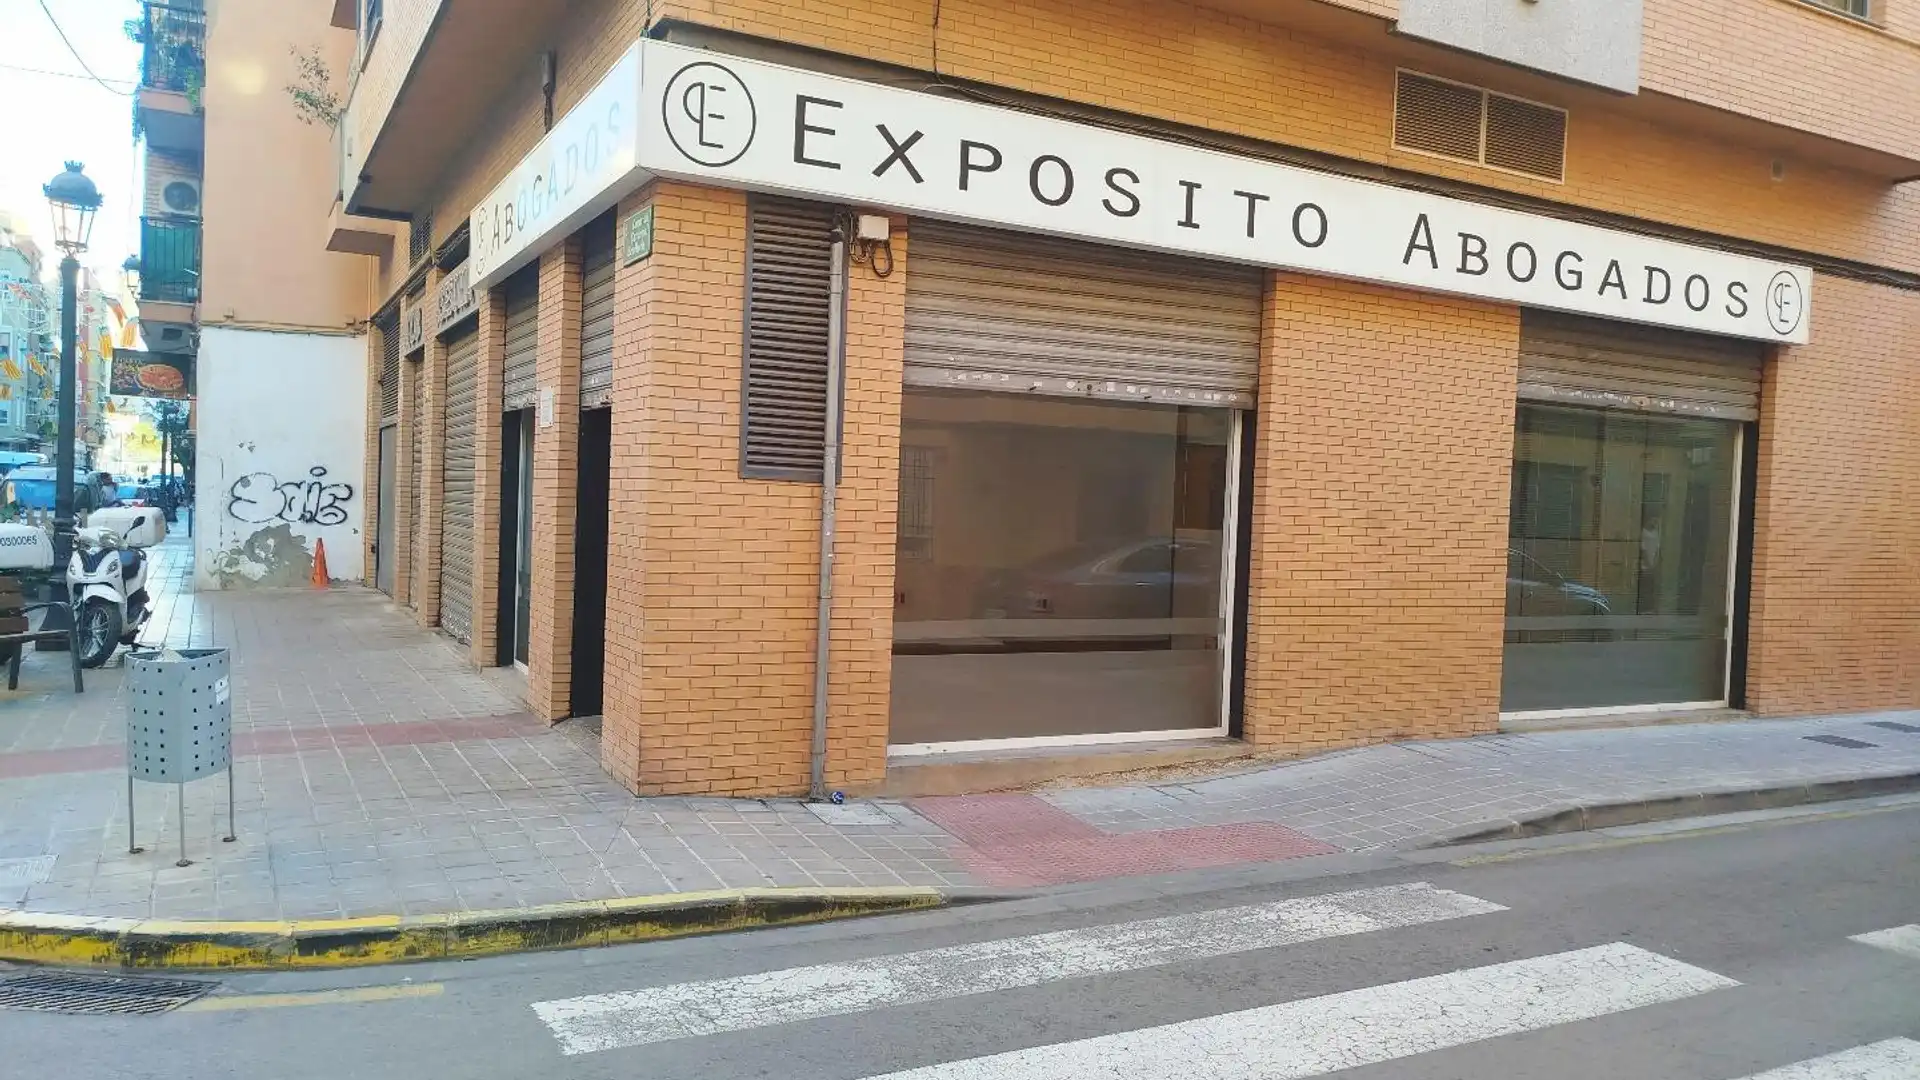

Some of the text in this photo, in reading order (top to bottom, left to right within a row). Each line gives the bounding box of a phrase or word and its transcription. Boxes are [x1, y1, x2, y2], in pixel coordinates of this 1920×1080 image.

[490, 100, 621, 256] ABOGADOS
[793, 94, 1328, 248] EXPOSITO
[1402, 213, 1748, 318] ABOGADOS
[0, 534, 38, 547] 0300065
